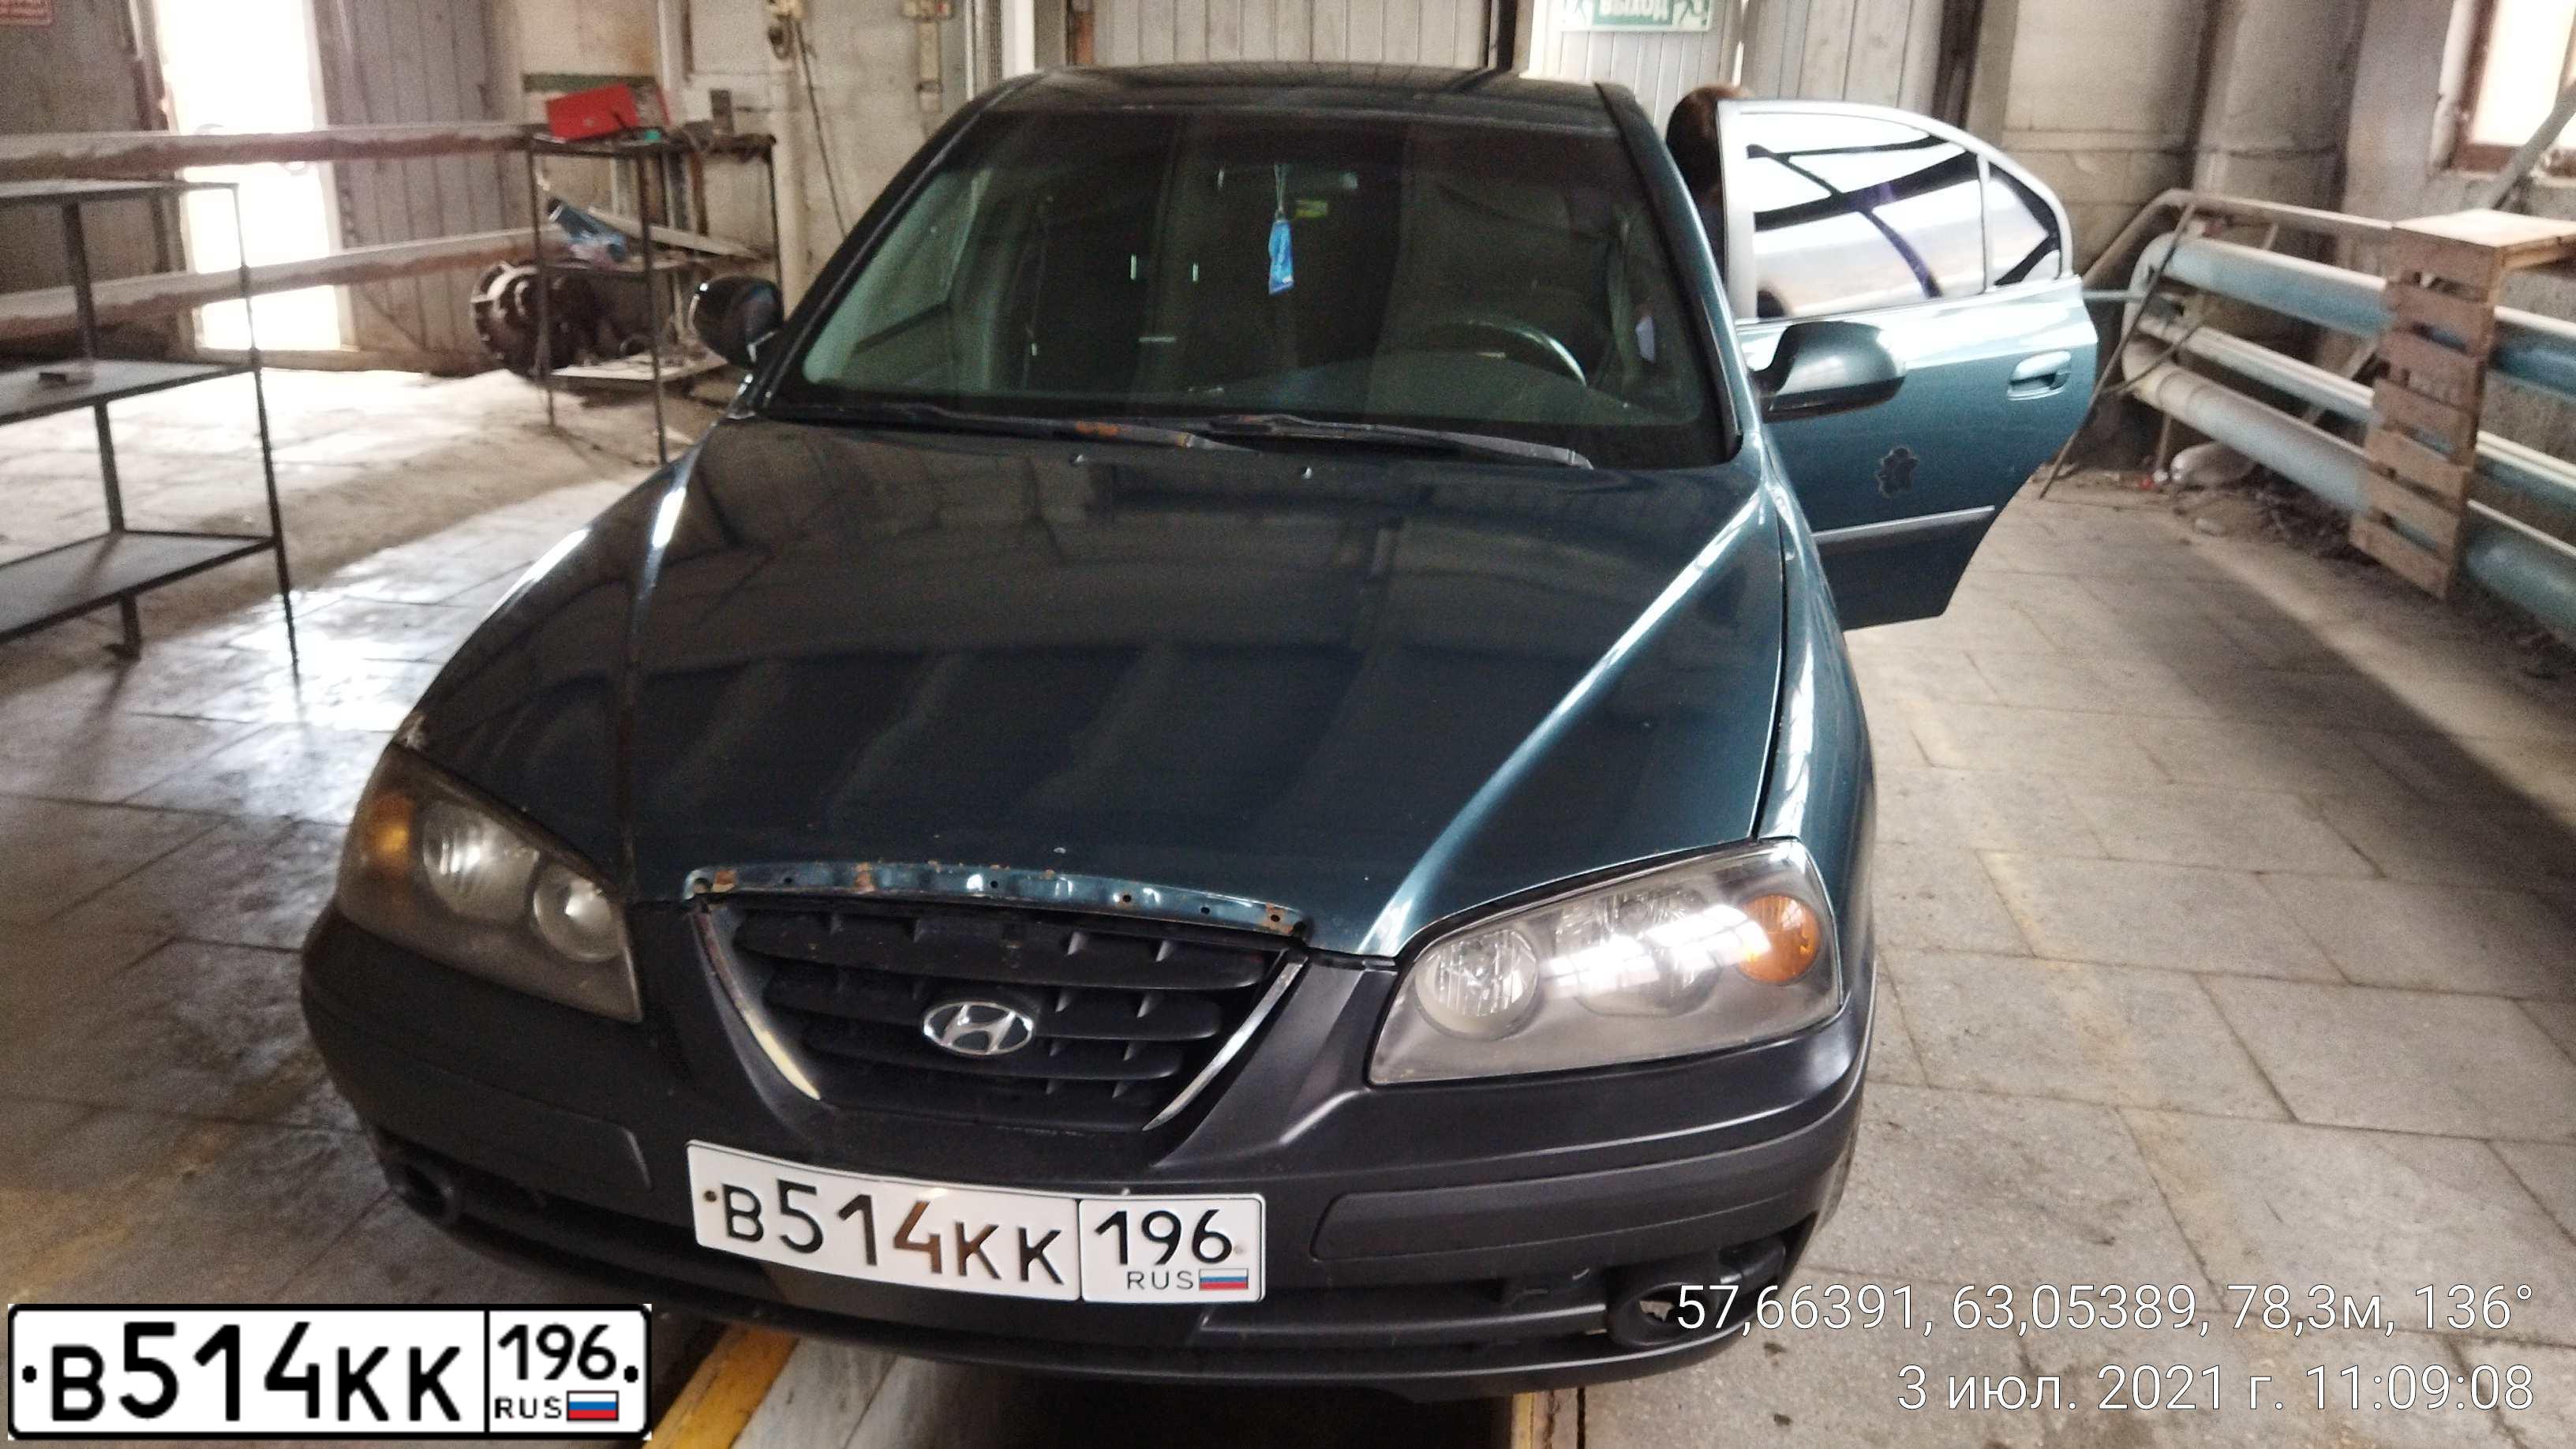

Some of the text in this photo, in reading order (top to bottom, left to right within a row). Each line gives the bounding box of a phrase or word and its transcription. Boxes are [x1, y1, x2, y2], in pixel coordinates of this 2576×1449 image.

[721, 1178, 1233, 1285] В514КК 196
[1127, 1270, 1194, 1290] RUS
